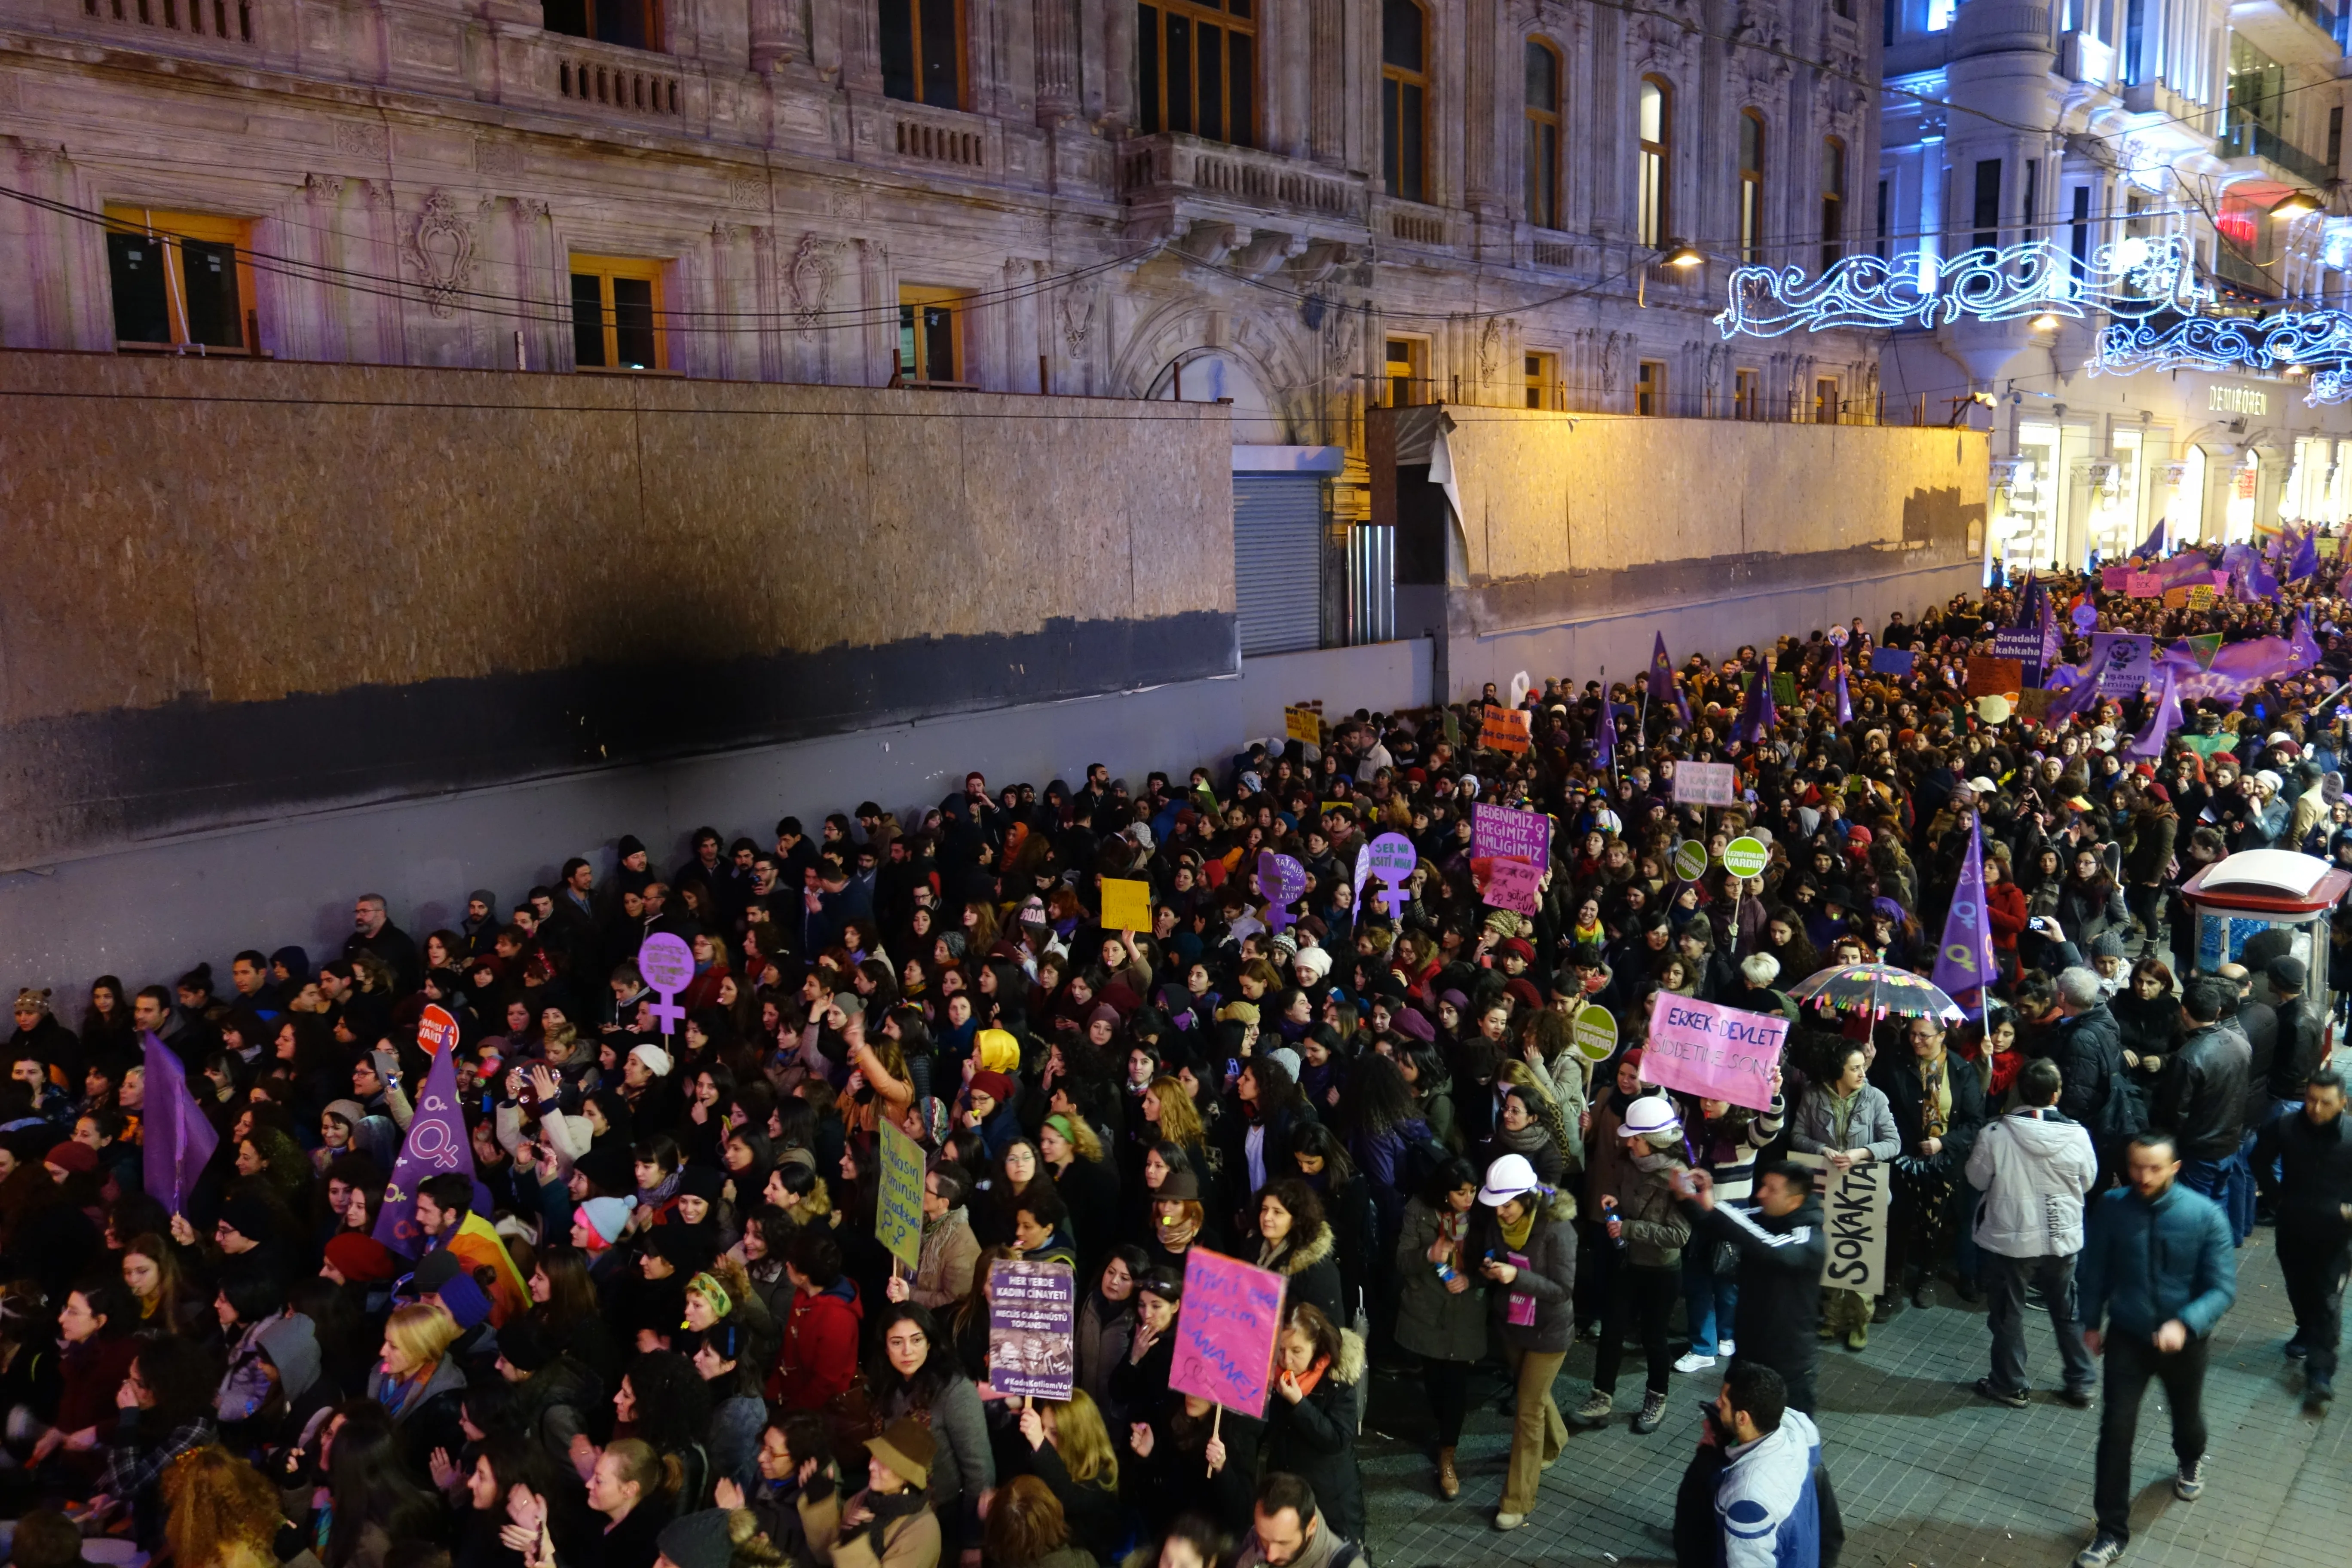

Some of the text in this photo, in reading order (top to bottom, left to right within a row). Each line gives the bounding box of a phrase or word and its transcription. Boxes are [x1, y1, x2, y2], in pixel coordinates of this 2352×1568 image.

[2208, 384, 2267, 416] DEMİRÖREN
[1997, 633, 2040, 643] Sıradaki
[1995, 646, 2040, 656] kahkaha
[1680, 849, 1704, 868] LEZBİYENLER
[1727, 850, 1764, 859] LEZBİYENLER
[1677, 854, 1700, 877] VARDIR
[1727, 857, 1763, 869] VARDIR
[419, 1027, 453, 1046] VARDR
[1577, 1029, 1613, 1051] VARDIR
[1828, 1163, 1879, 1285] SOKAKTA
[1009, 1276, 1054, 1287] HER YERDE
[996, 1287, 1067, 1301] KADIN CİNAYETİ
[1021, 1311, 1068, 1322] OLAĞANÜSTÜ
